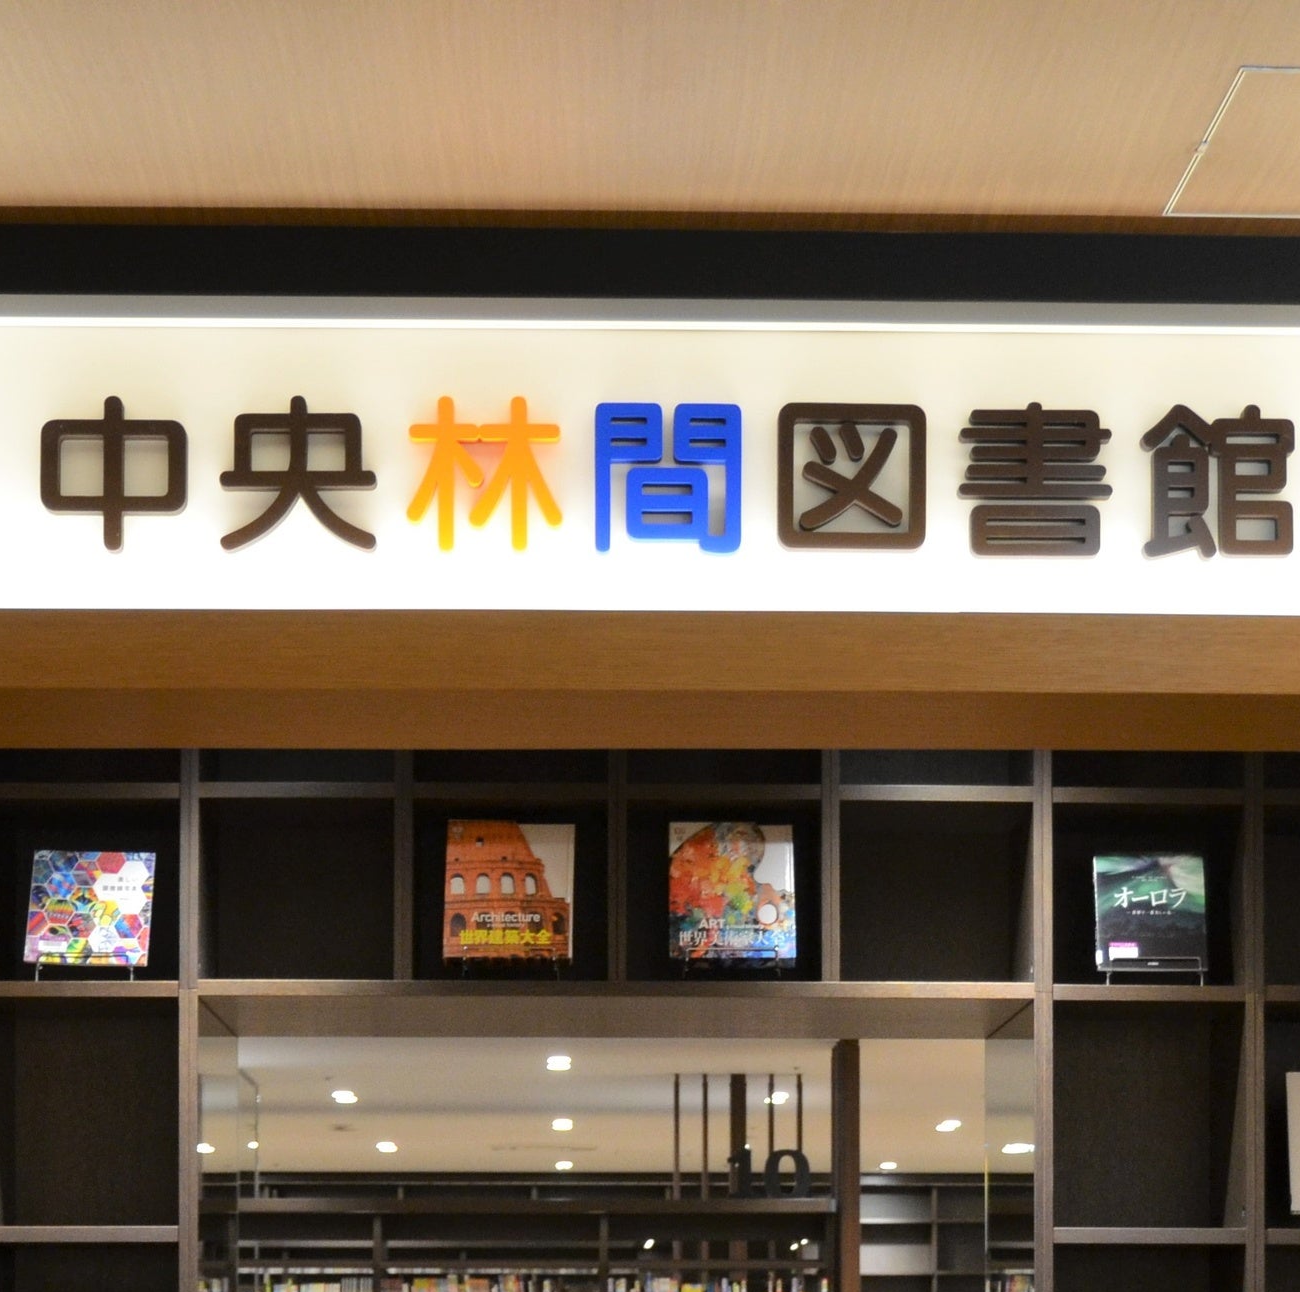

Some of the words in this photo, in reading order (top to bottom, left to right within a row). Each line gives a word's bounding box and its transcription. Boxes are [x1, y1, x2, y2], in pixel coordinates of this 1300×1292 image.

[40, 396, 1295, 558] 中央林間図書館
[1113, 886, 1188, 908] オーロラ
[471, 911, 541, 922] Architecture
[699, 918, 726, 929] ART
[727, 1148, 811, 1198] 10
